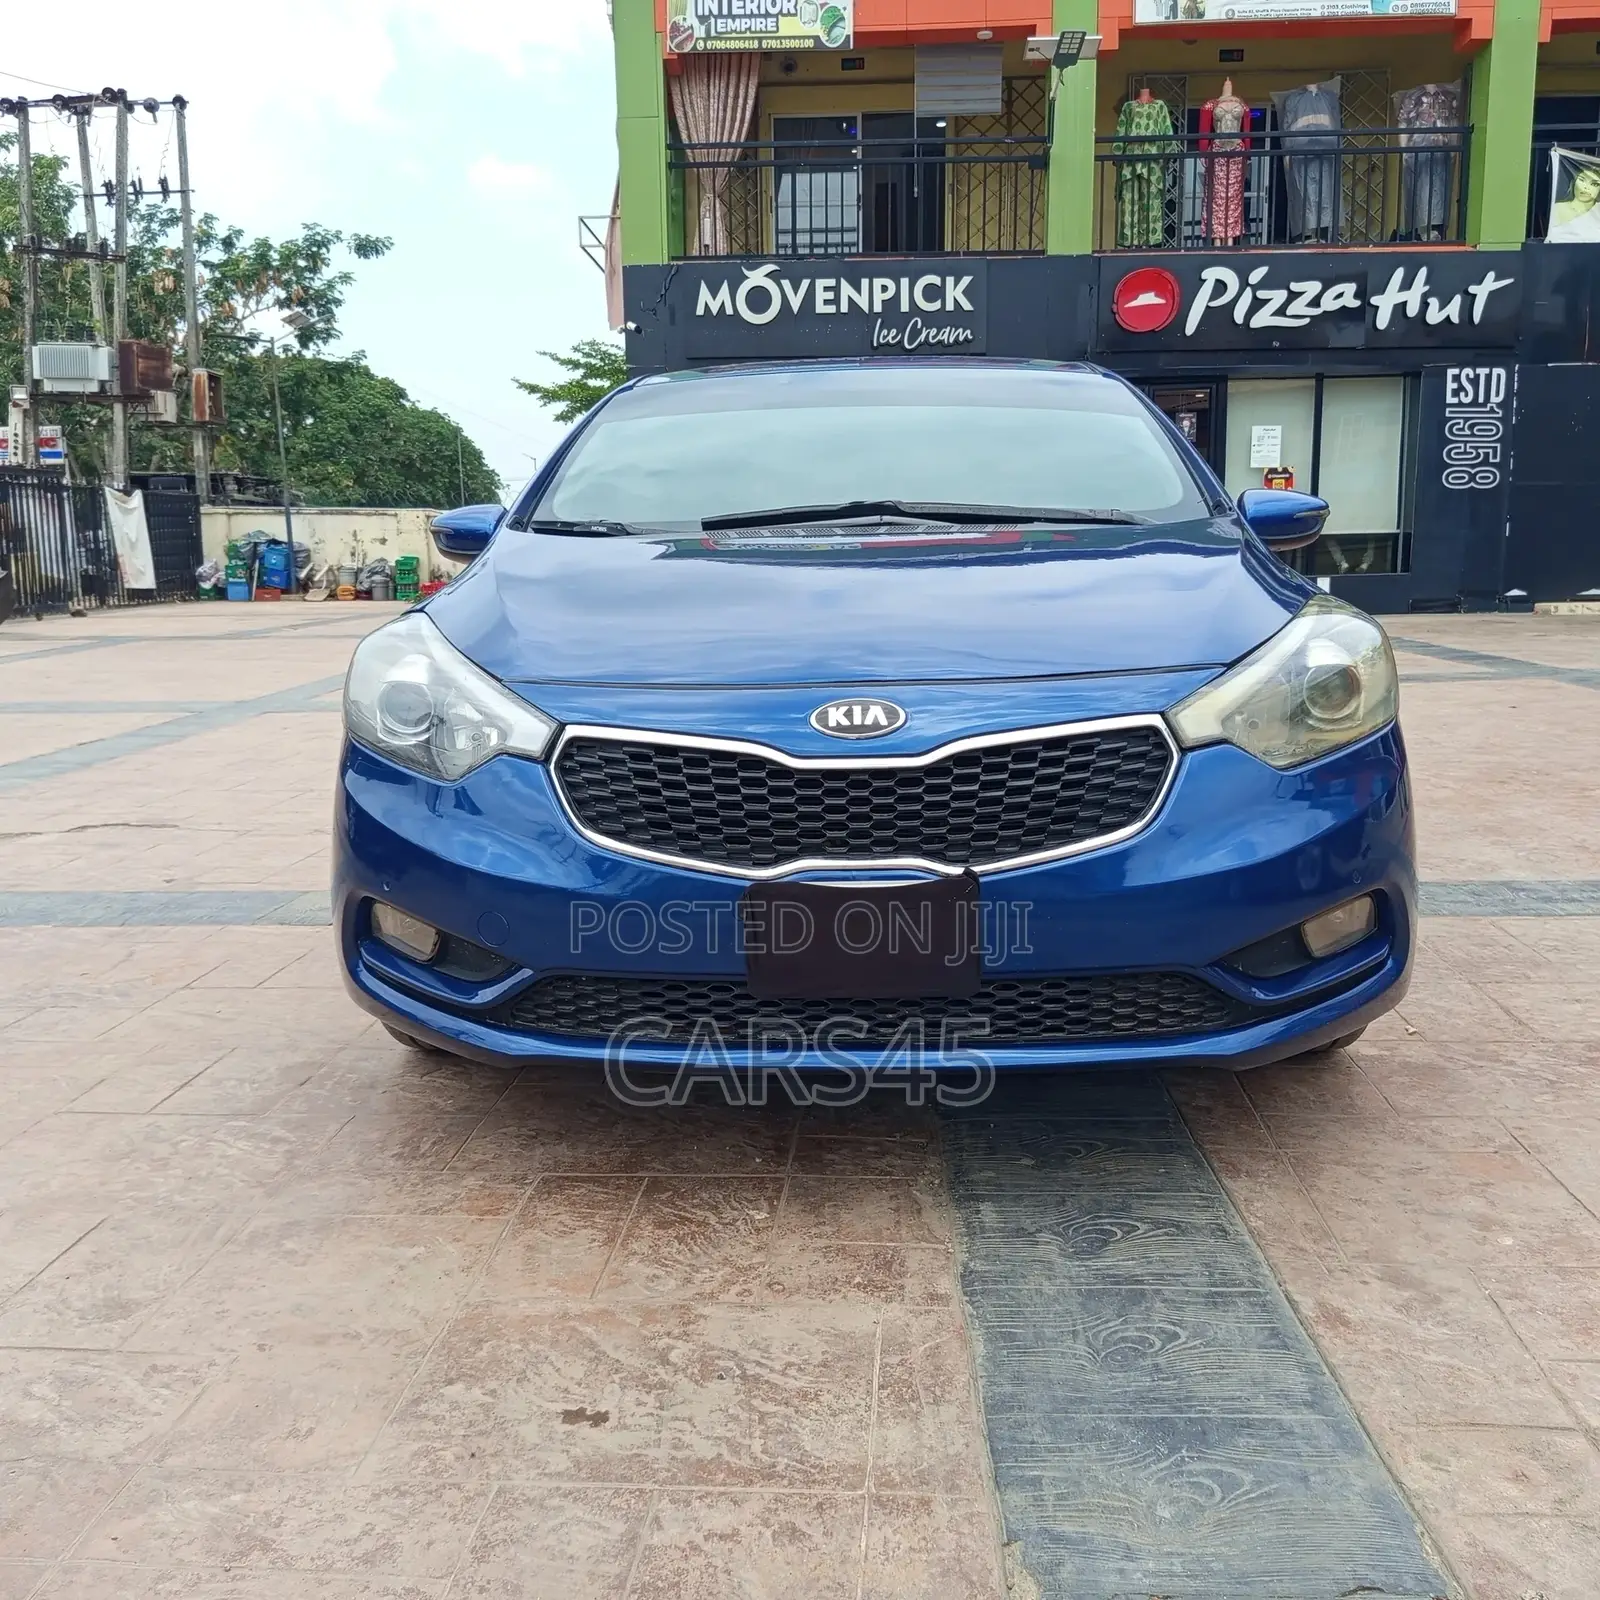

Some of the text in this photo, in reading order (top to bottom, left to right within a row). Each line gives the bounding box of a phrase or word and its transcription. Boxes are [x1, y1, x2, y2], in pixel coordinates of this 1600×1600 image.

[697, 0, 797, 15] INTERIOR
[717, 18, 777, 32] EMPIRE
[762, 39, 814, 48] 07013500100
[1184, 266, 1514, 337] Pizza Hut
[873, 317, 973, 350] Ice Cream
[1445, 367, 1506, 404] ESTD
[1441, 403, 1503, 489] 1958
[826, 705, 889, 727] KIA
